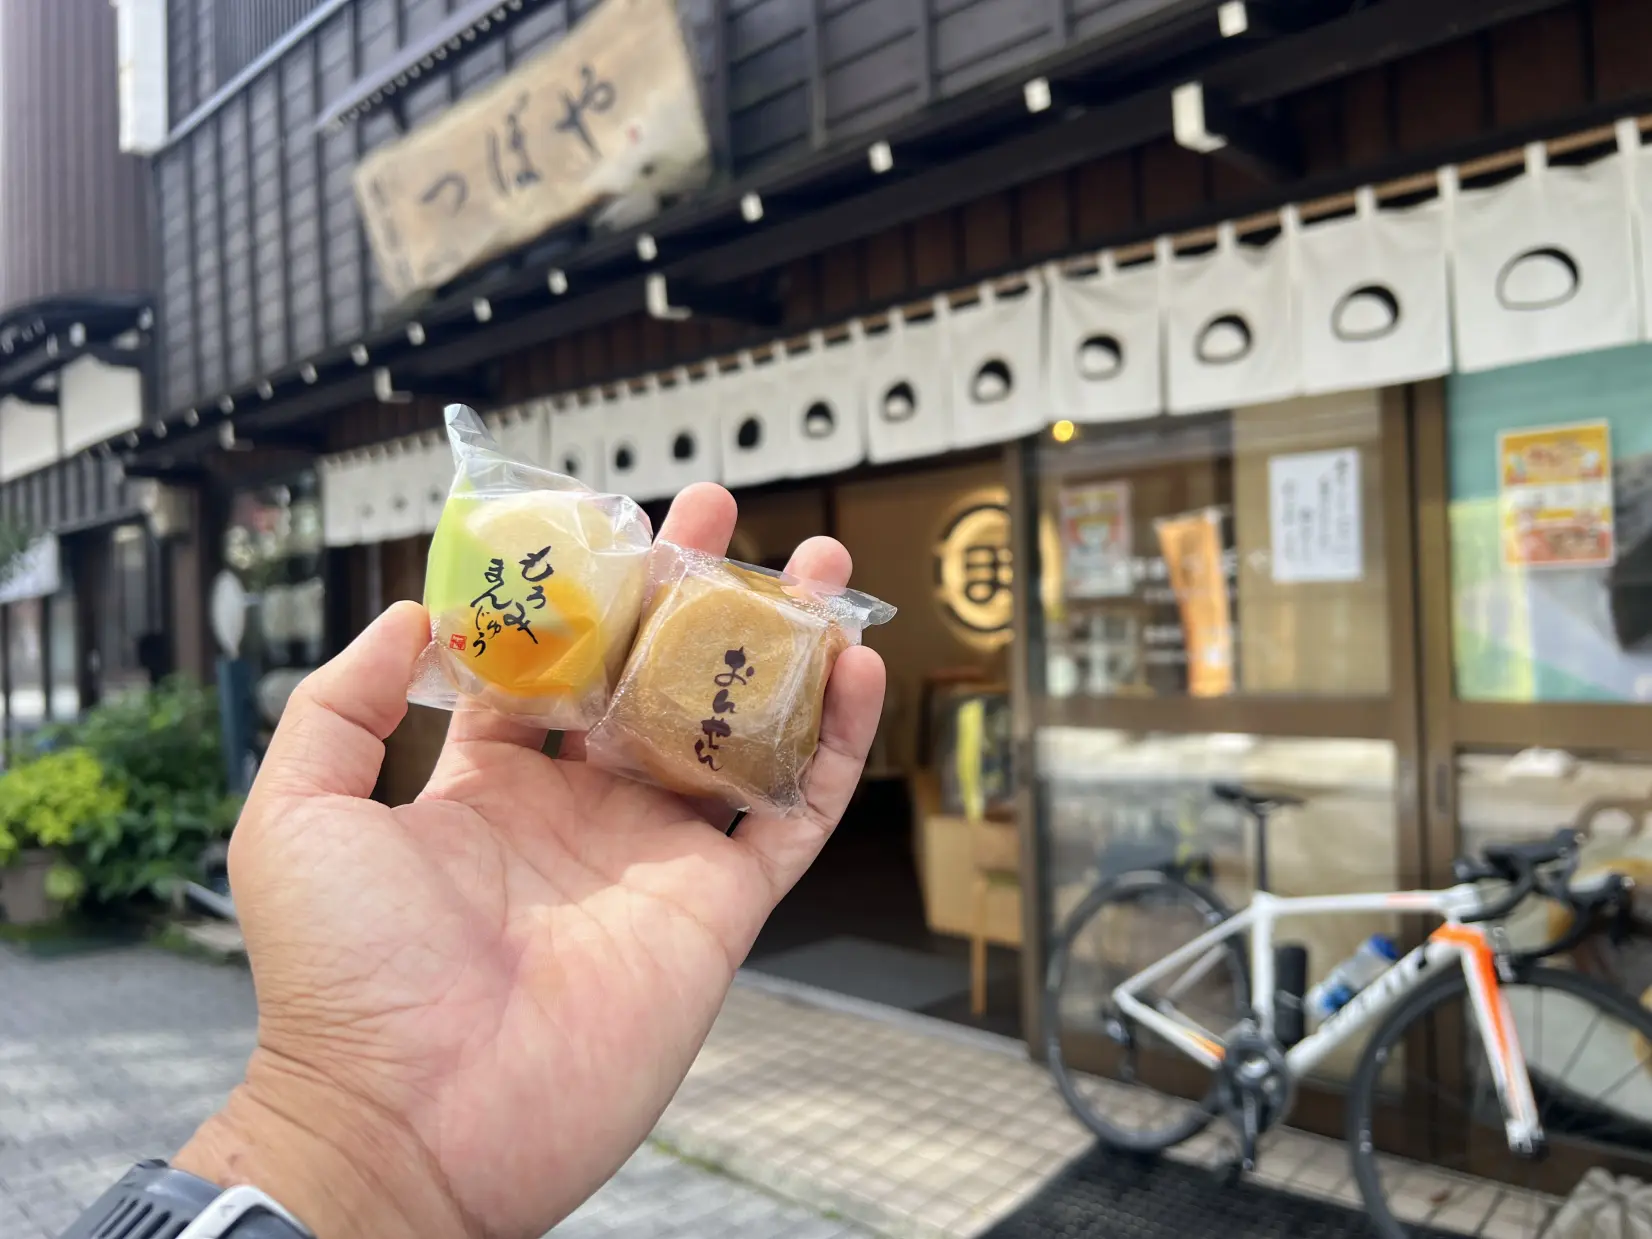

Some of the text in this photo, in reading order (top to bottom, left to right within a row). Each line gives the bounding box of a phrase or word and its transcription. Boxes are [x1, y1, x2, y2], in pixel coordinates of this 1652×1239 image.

[418, 63, 617, 219] つぼや
[470, 558, 513, 658] まんじゅう
[503, 546, 554, 645] もろみ
[694, 645, 755, 771] おんせん
